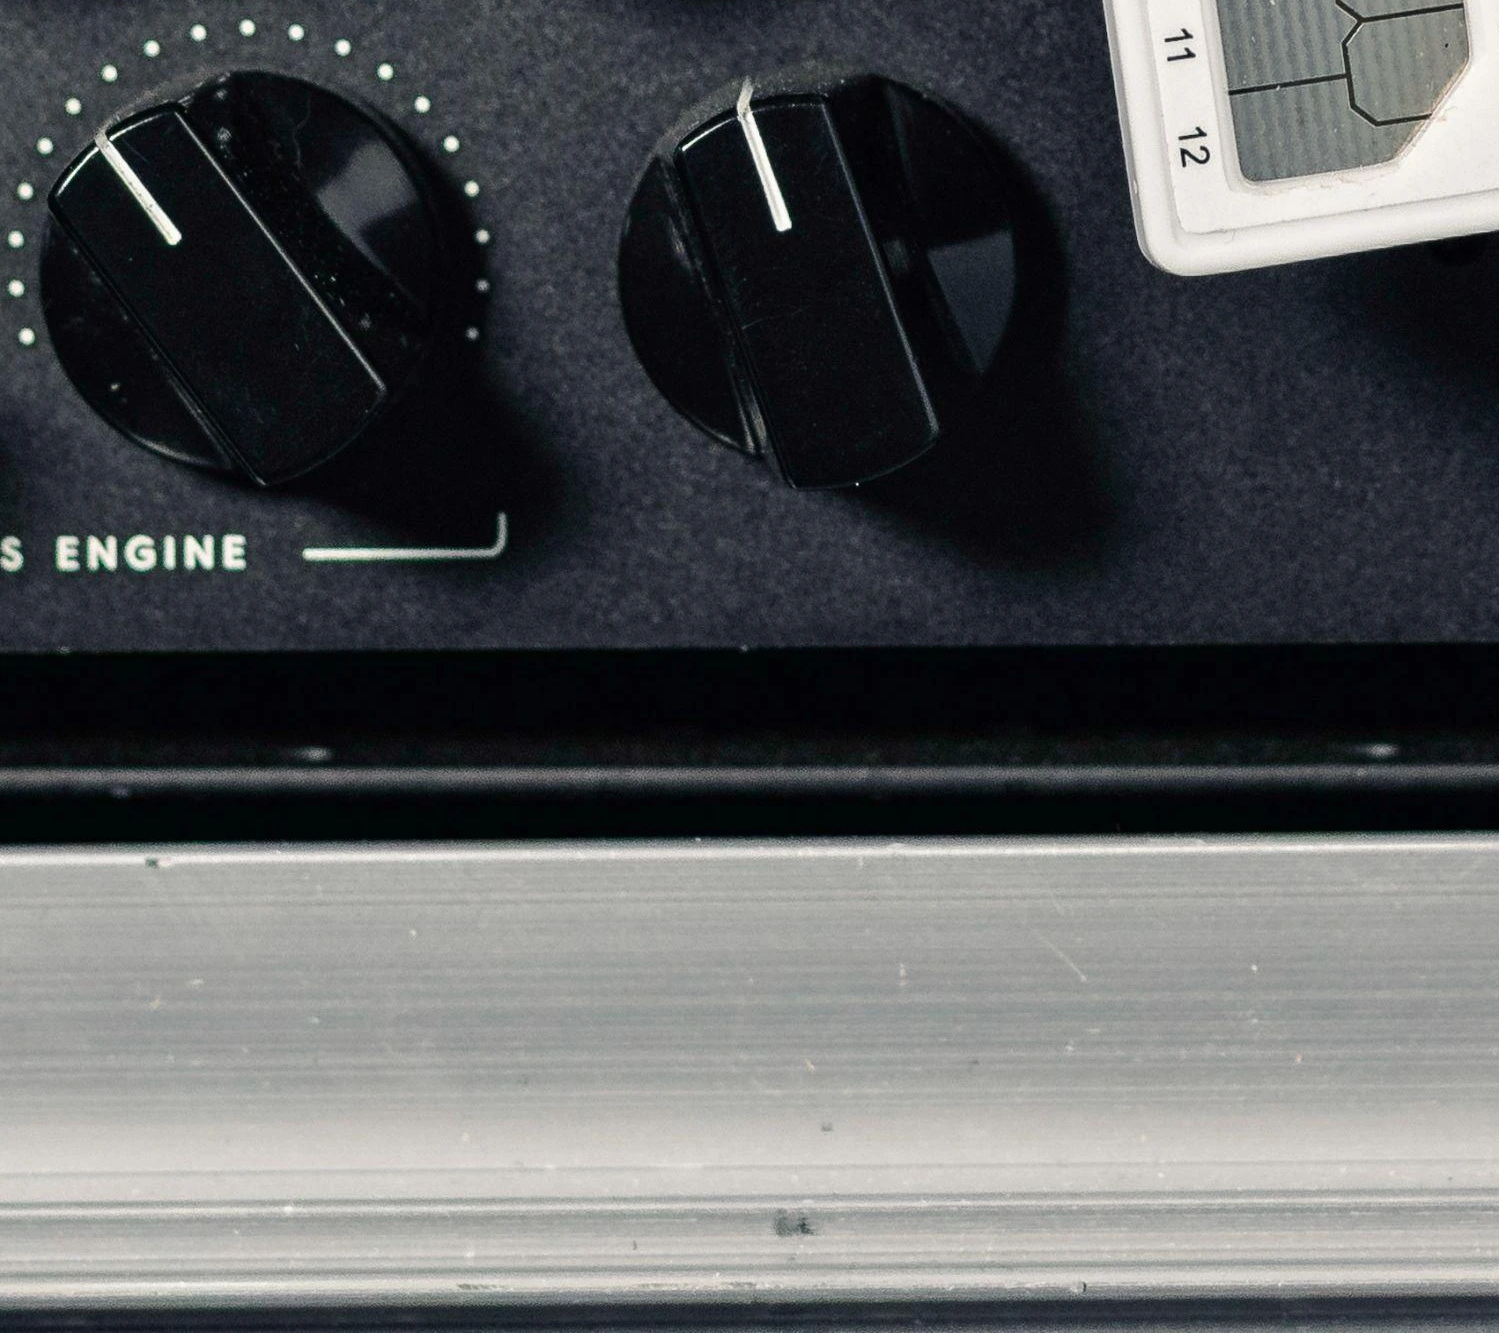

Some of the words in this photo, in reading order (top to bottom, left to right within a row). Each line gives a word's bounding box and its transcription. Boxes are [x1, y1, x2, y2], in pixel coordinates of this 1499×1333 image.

[1164, 28, 1196, 62] 11
[1178, 126, 1211, 168] 12
[56, 534, 246, 571] ENGINE
